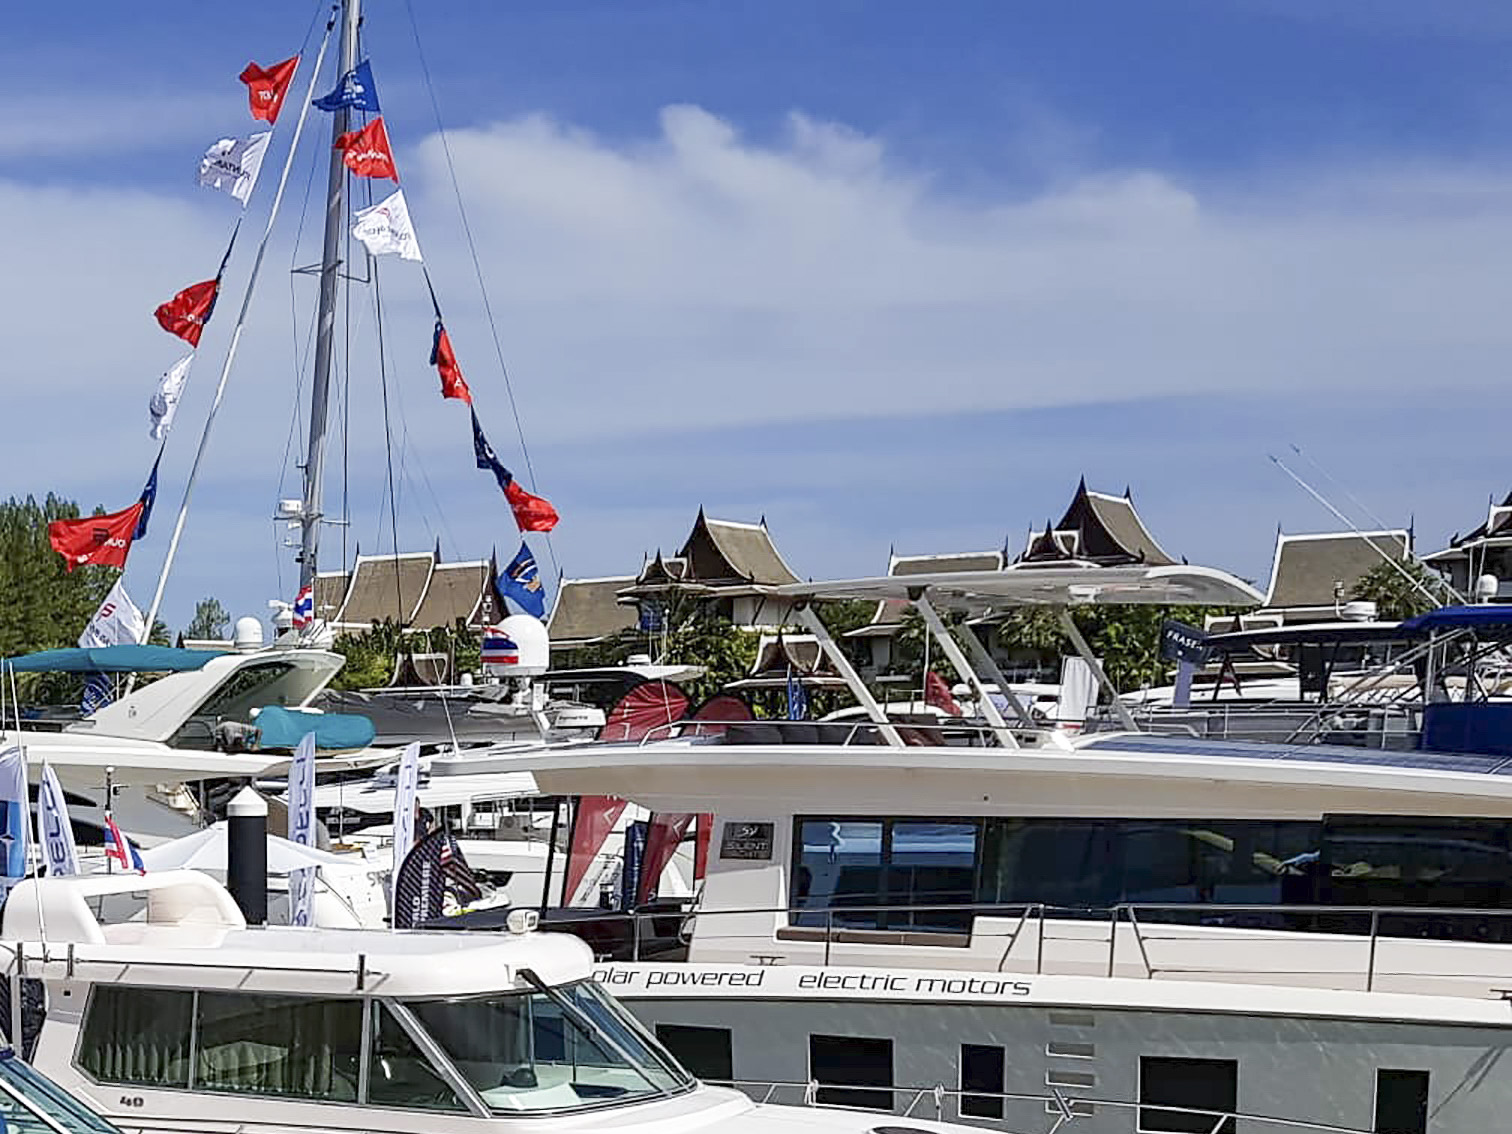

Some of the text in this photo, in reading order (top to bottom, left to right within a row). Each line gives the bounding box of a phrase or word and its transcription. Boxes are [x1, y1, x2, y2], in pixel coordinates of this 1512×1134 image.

[591, 966, 1032, 996] olar powered electric motors
